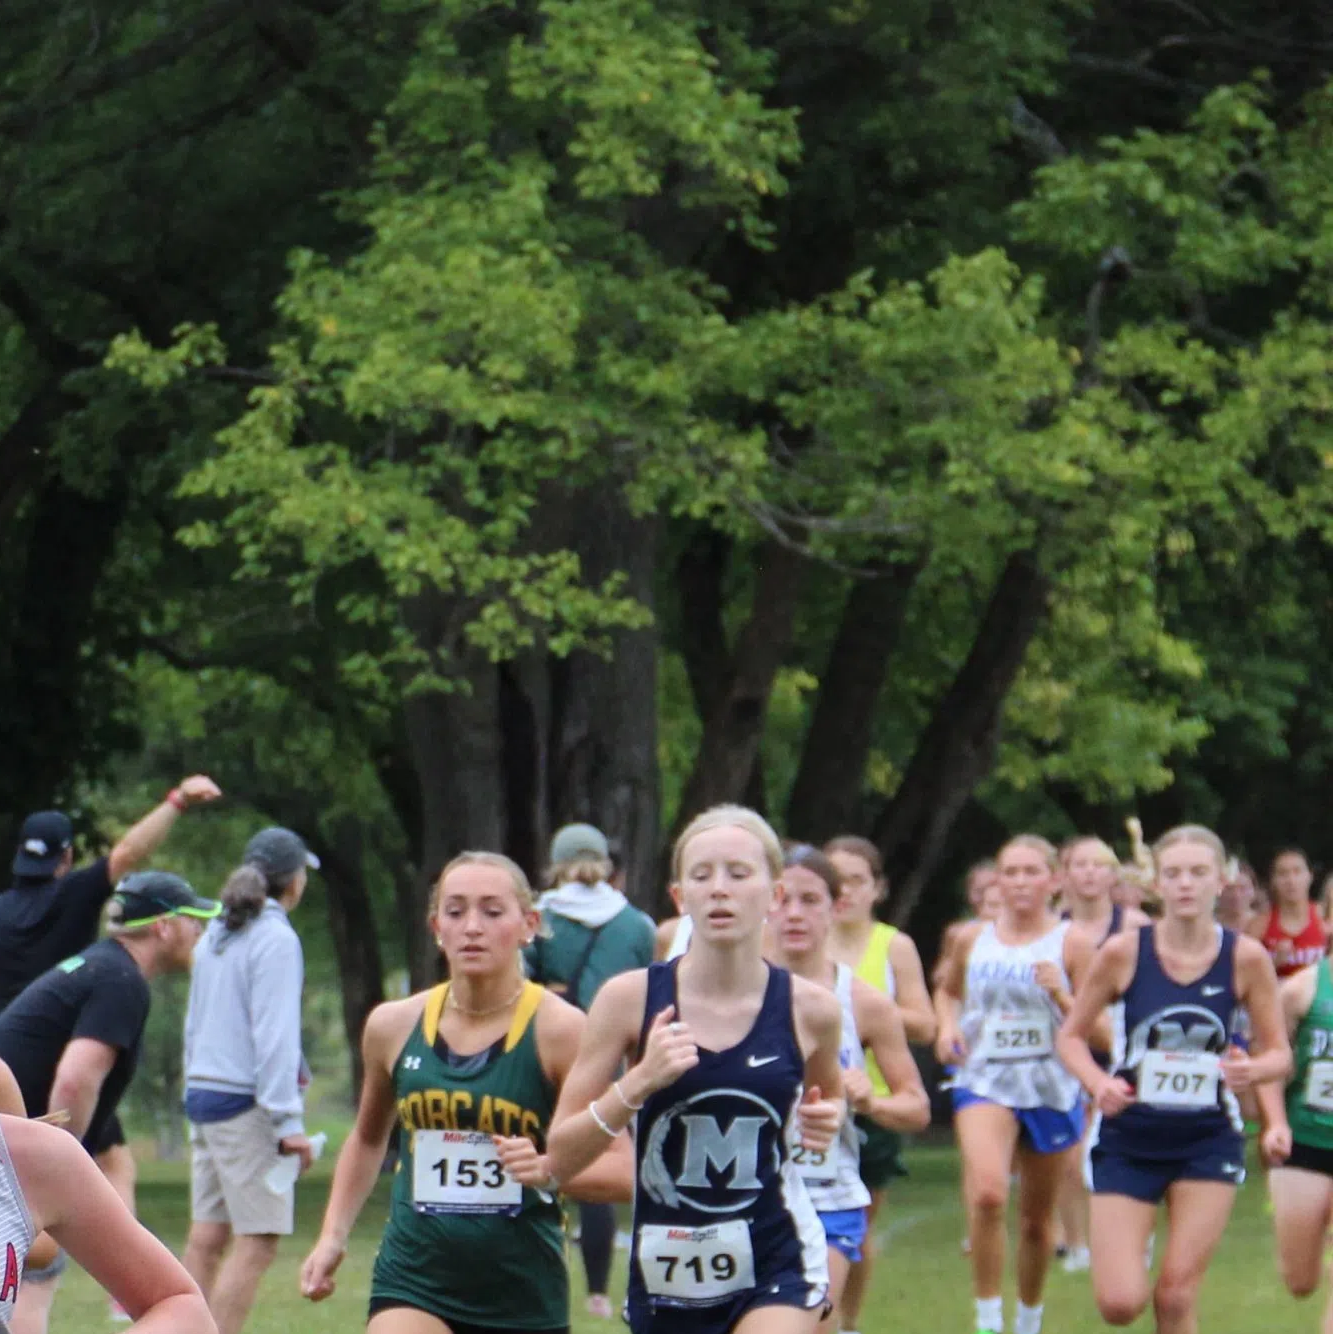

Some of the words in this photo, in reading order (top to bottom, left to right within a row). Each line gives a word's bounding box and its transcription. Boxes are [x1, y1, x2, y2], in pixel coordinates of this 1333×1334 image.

[1154, 1071, 1208, 1095] 707
[675, 1114, 767, 1190] M
[432, 1158, 505, 1188] 153
[656, 1253, 737, 1284] 719
